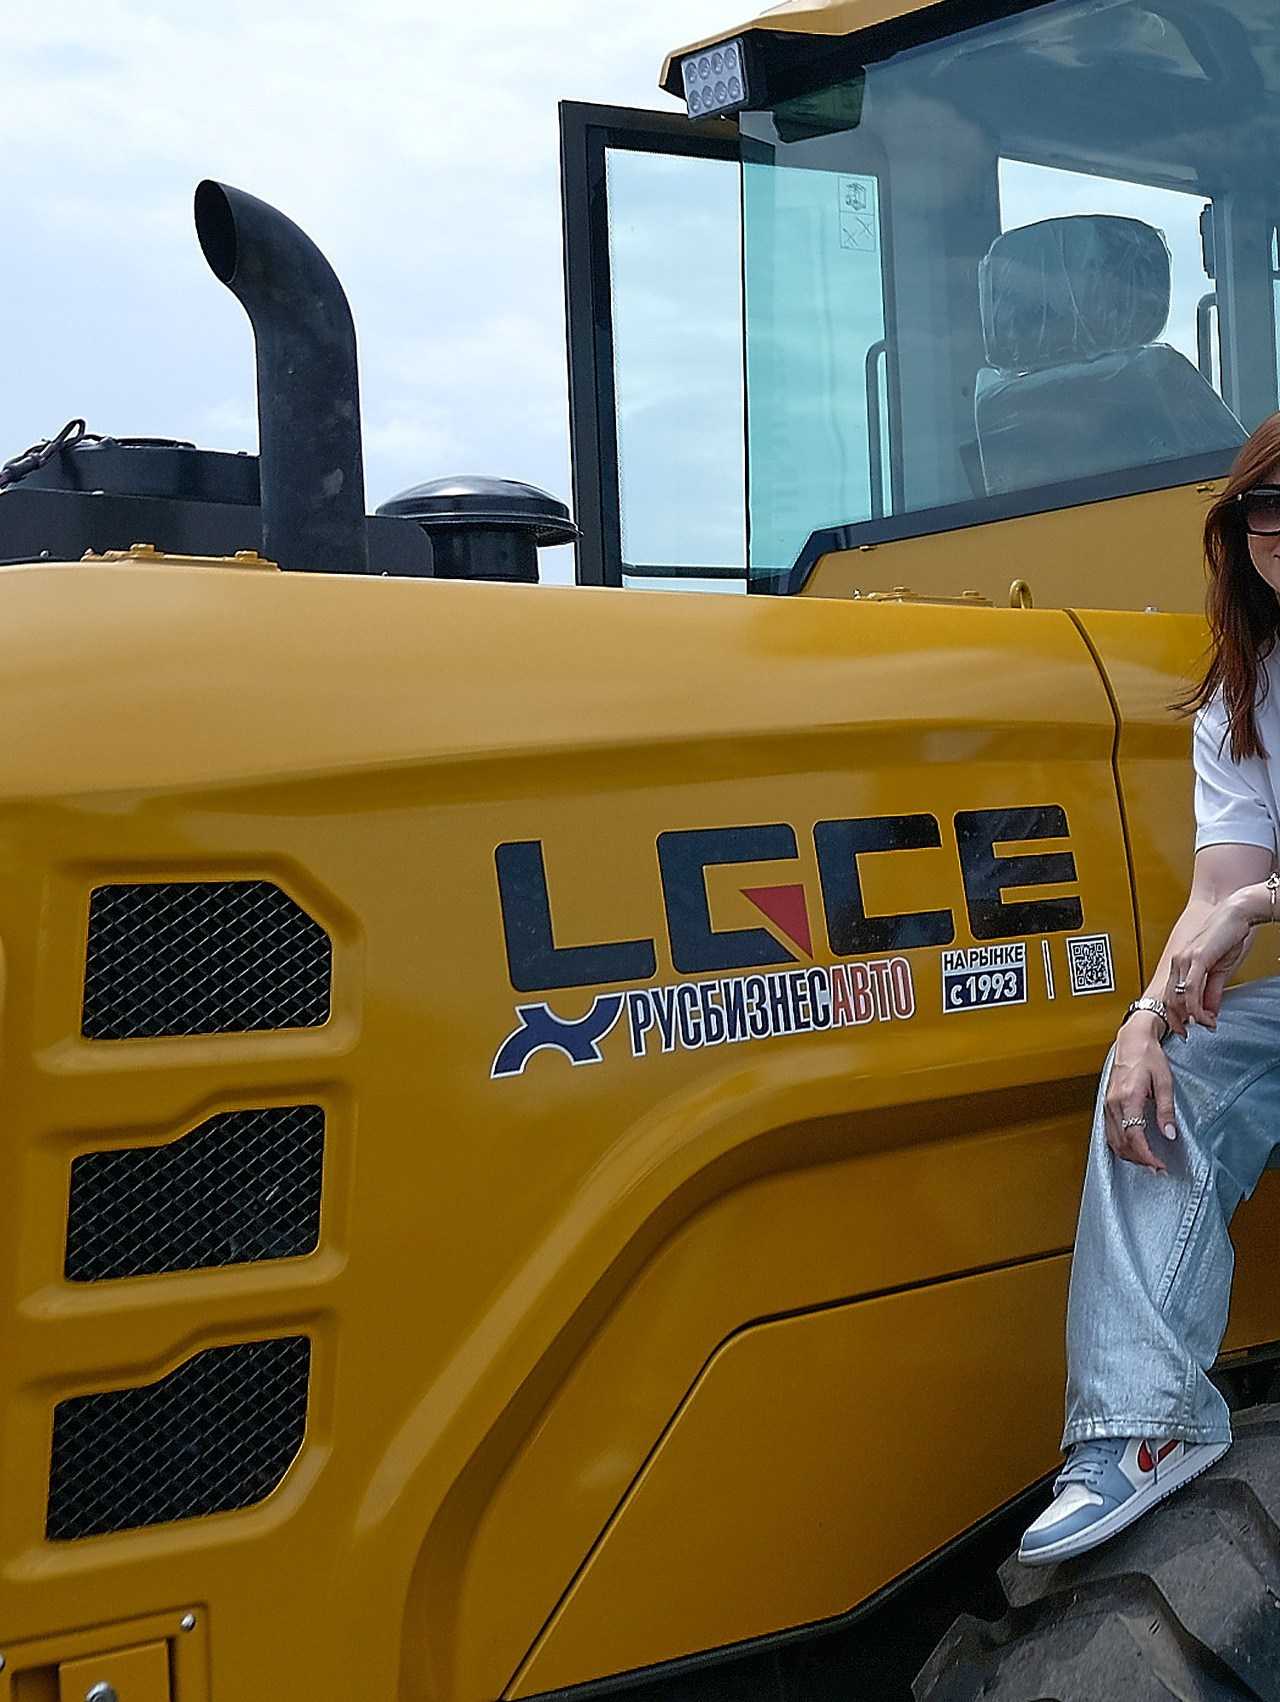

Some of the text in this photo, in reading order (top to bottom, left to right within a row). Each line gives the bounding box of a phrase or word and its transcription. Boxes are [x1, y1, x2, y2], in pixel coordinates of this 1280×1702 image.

[494, 804, 1085, 993] LGCE
[944, 945, 1024, 971] НА РЫНКЕ
[966, 971, 1018, 1003] 1993
[627, 957, 916, 1057] РУСБИЗНЕСАВТО
